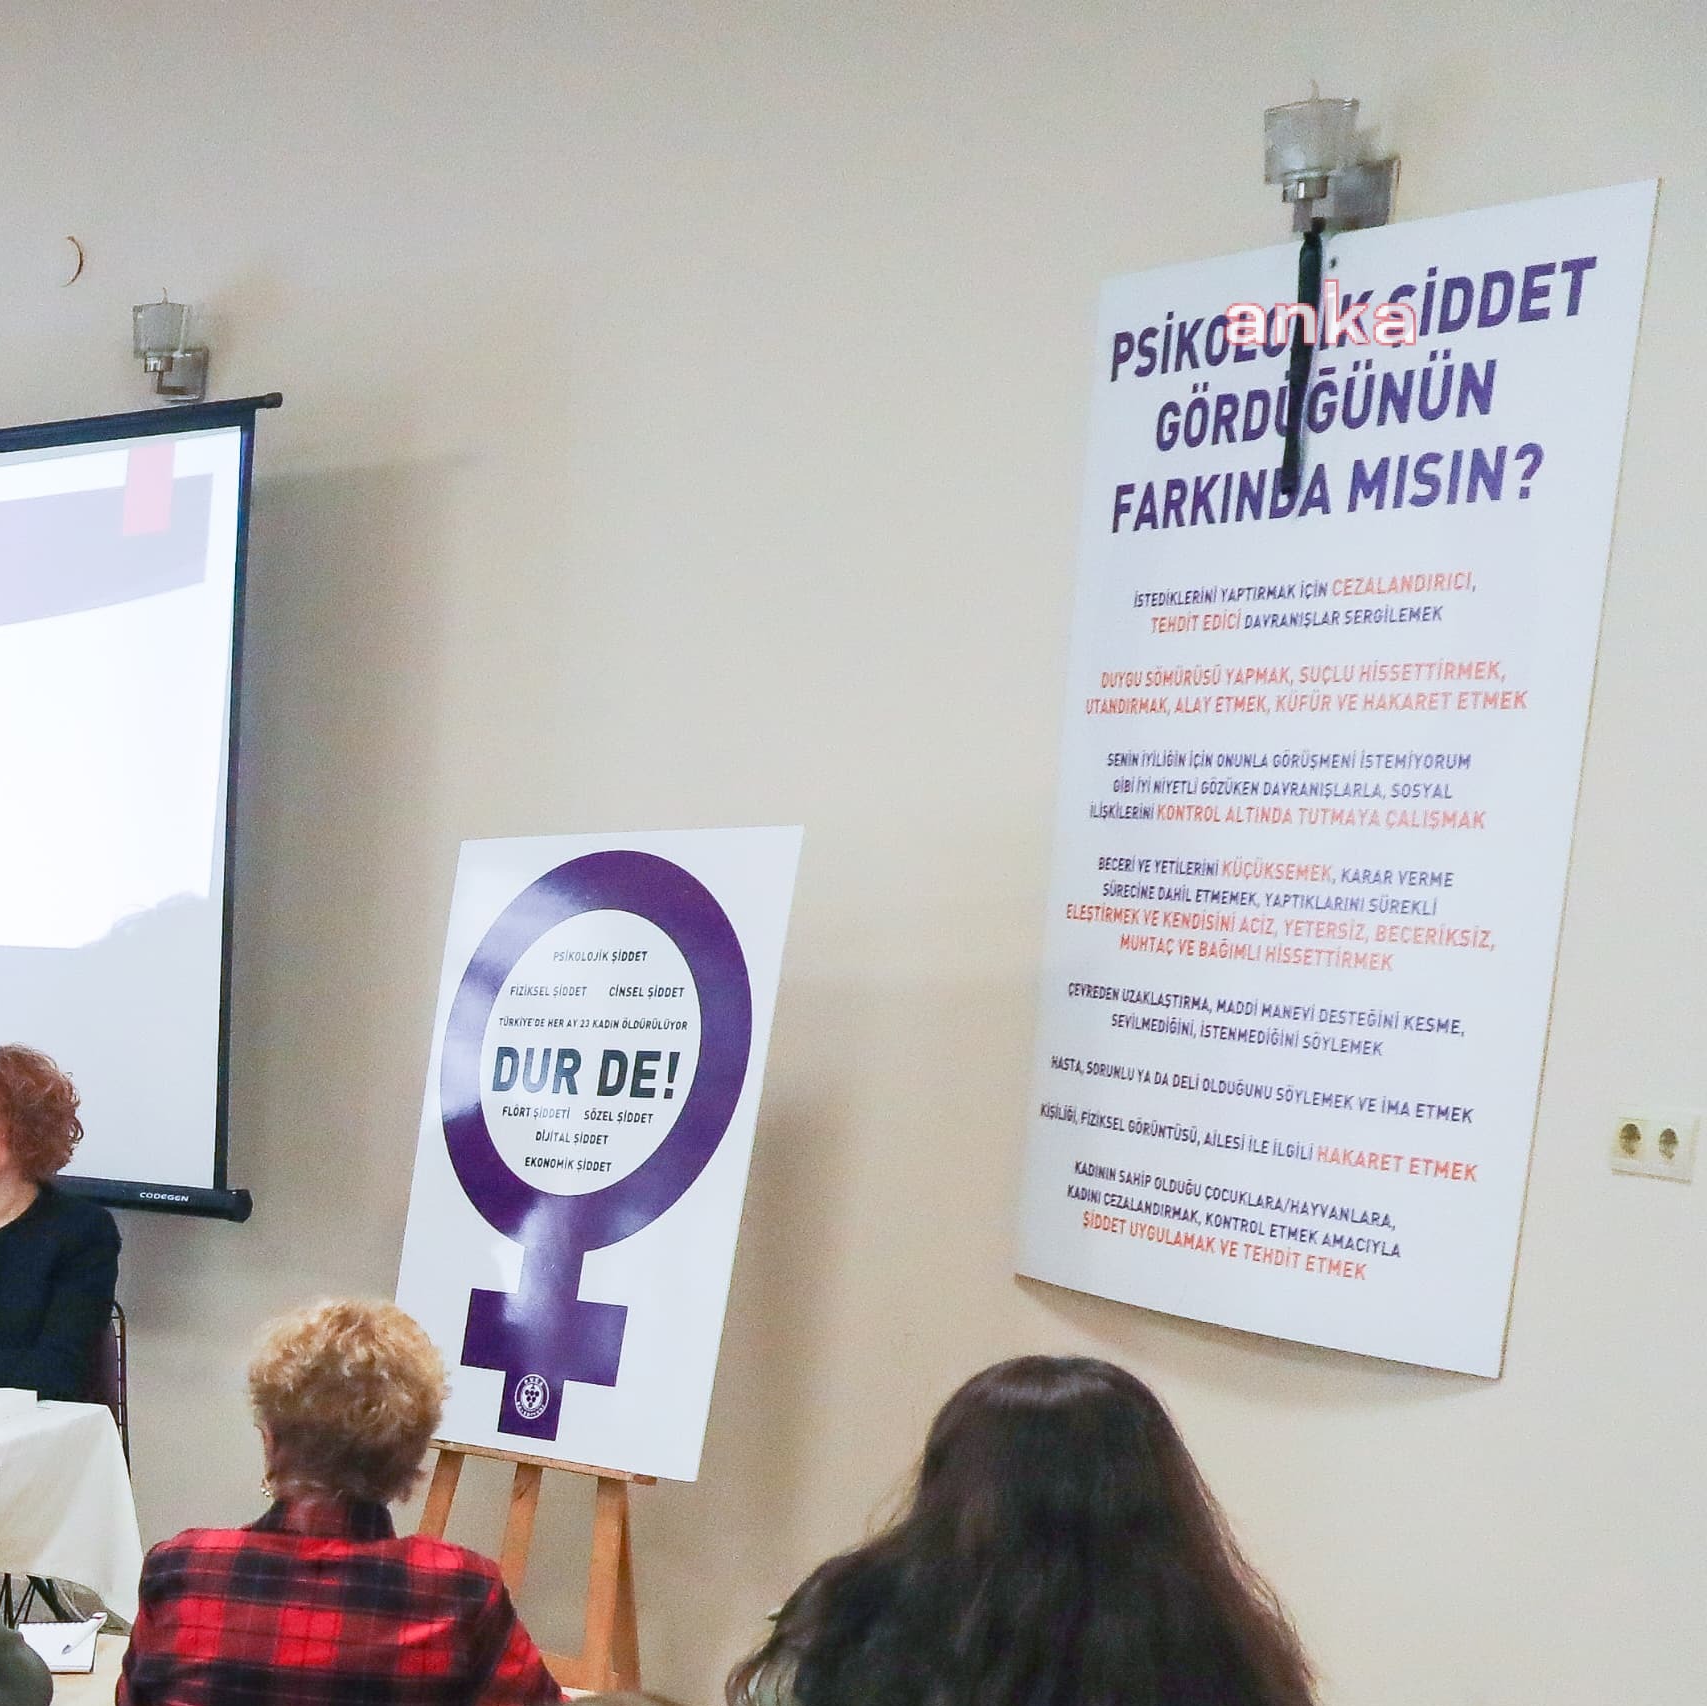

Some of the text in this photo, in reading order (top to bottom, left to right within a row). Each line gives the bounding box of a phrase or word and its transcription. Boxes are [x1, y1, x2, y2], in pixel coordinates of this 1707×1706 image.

[1112, 442, 1544, 533] FARKINDA MISIN?
[1134, 574, 1476, 607] İSTEDİKLERİNİ YAPTIRMAK İÇİN CEZALANDIRICI,
[1151, 606, 1442, 633] TEHDİT EDİCİ DAVRANIŞLAR SERGİLEMEK
[1101, 660, 1506, 688] DUYGU SÖMÜRÜSÜ YAPMAK, SUÇLU HİSSETTİRMEK,
[1174, 697, 1211, 714] ALAY
[1215, 696, 1270, 715] ETMEK,
[1276, 691, 1332, 712] KÜFÜR
[1338, 695, 1357, 711] VE
[1363, 693, 1451, 711] HAKARET
[1458, 692, 1527, 710] ETMEK
[1272, 750, 1471, 769] GÖRÜŞMENİ İSTEMİYORUM
[1391, 783, 1452, 798] SOSYAL
[1157, 806, 1486, 830] KONTROL ALTINDA TUTMAYA ÇALIŞMAK
[1222, 857, 1454, 887] KÜÇÜKSEMEK, KARAR VERME
[1265, 893, 1437, 916] YAPTIKLARINI SÜREKLİ
[1142, 909, 1497, 951] VE KENDİSİNİ ACİZ, YETERSİZ, BECERİKSİZ,
[553, 950, 648, 962] PSİKOLOJİK ŞİDDET
[1120, 935, 1394, 971] MUHTAÇ VE BAĞIMLI HİSSETTİRMEK
[510, 985, 587, 997] FİZİKSEL ŞİDDET
[609, 986, 685, 998] CİNSEL ŞİDDET
[547, 1019, 564, 1027] HER
[622, 1018, 687, 1030] ÖLDÜRÜLÜYOR
[1216, 996, 1258, 1015] MADDİ
[1262, 1001, 1315, 1020] MANEVİ
[1319, 1006, 1398, 1028] DESTEĞİNİ
[1403, 1013, 1465, 1037] KESME,
[1303, 1030, 1383, 1056] SÖYLEMEK
[492, 1047, 680, 1099] DUR DE!
[1137, 1067, 1473, 1124] YA DA DELİ OLDUĞUNU SÖYLEMEK VE İMA ETMEK
[502, 1107, 570, 1119] FLÖRT ŞİDDETİ
[584, 1109, 653, 1123] SÖZEL ŞİDDET
[536, 1131, 608, 1144] DİJİTAL ŞİDDET
[525, 1158, 611, 1171] EKONOMİK ŞİDDET
[1204, 1127, 1477, 1182] AİLESİ İLE İLGİLİ HAKARET ETMEK
[1120, 1168, 1201, 1196] SAHİP OLDUĞU
[1206, 1209, 1264, 1233] KONTROL
[1270, 1220, 1317, 1242] ETMEK
[1323, 1230, 1401, 1257] AMACIYLA
[1130, 1221, 1217, 1252] UYGULAMAK
[1221, 1238, 1237, 1255] VE
[1244, 1242, 1299, 1267] TEHDİT
[1306, 1253, 1366, 1280] ETMEK
